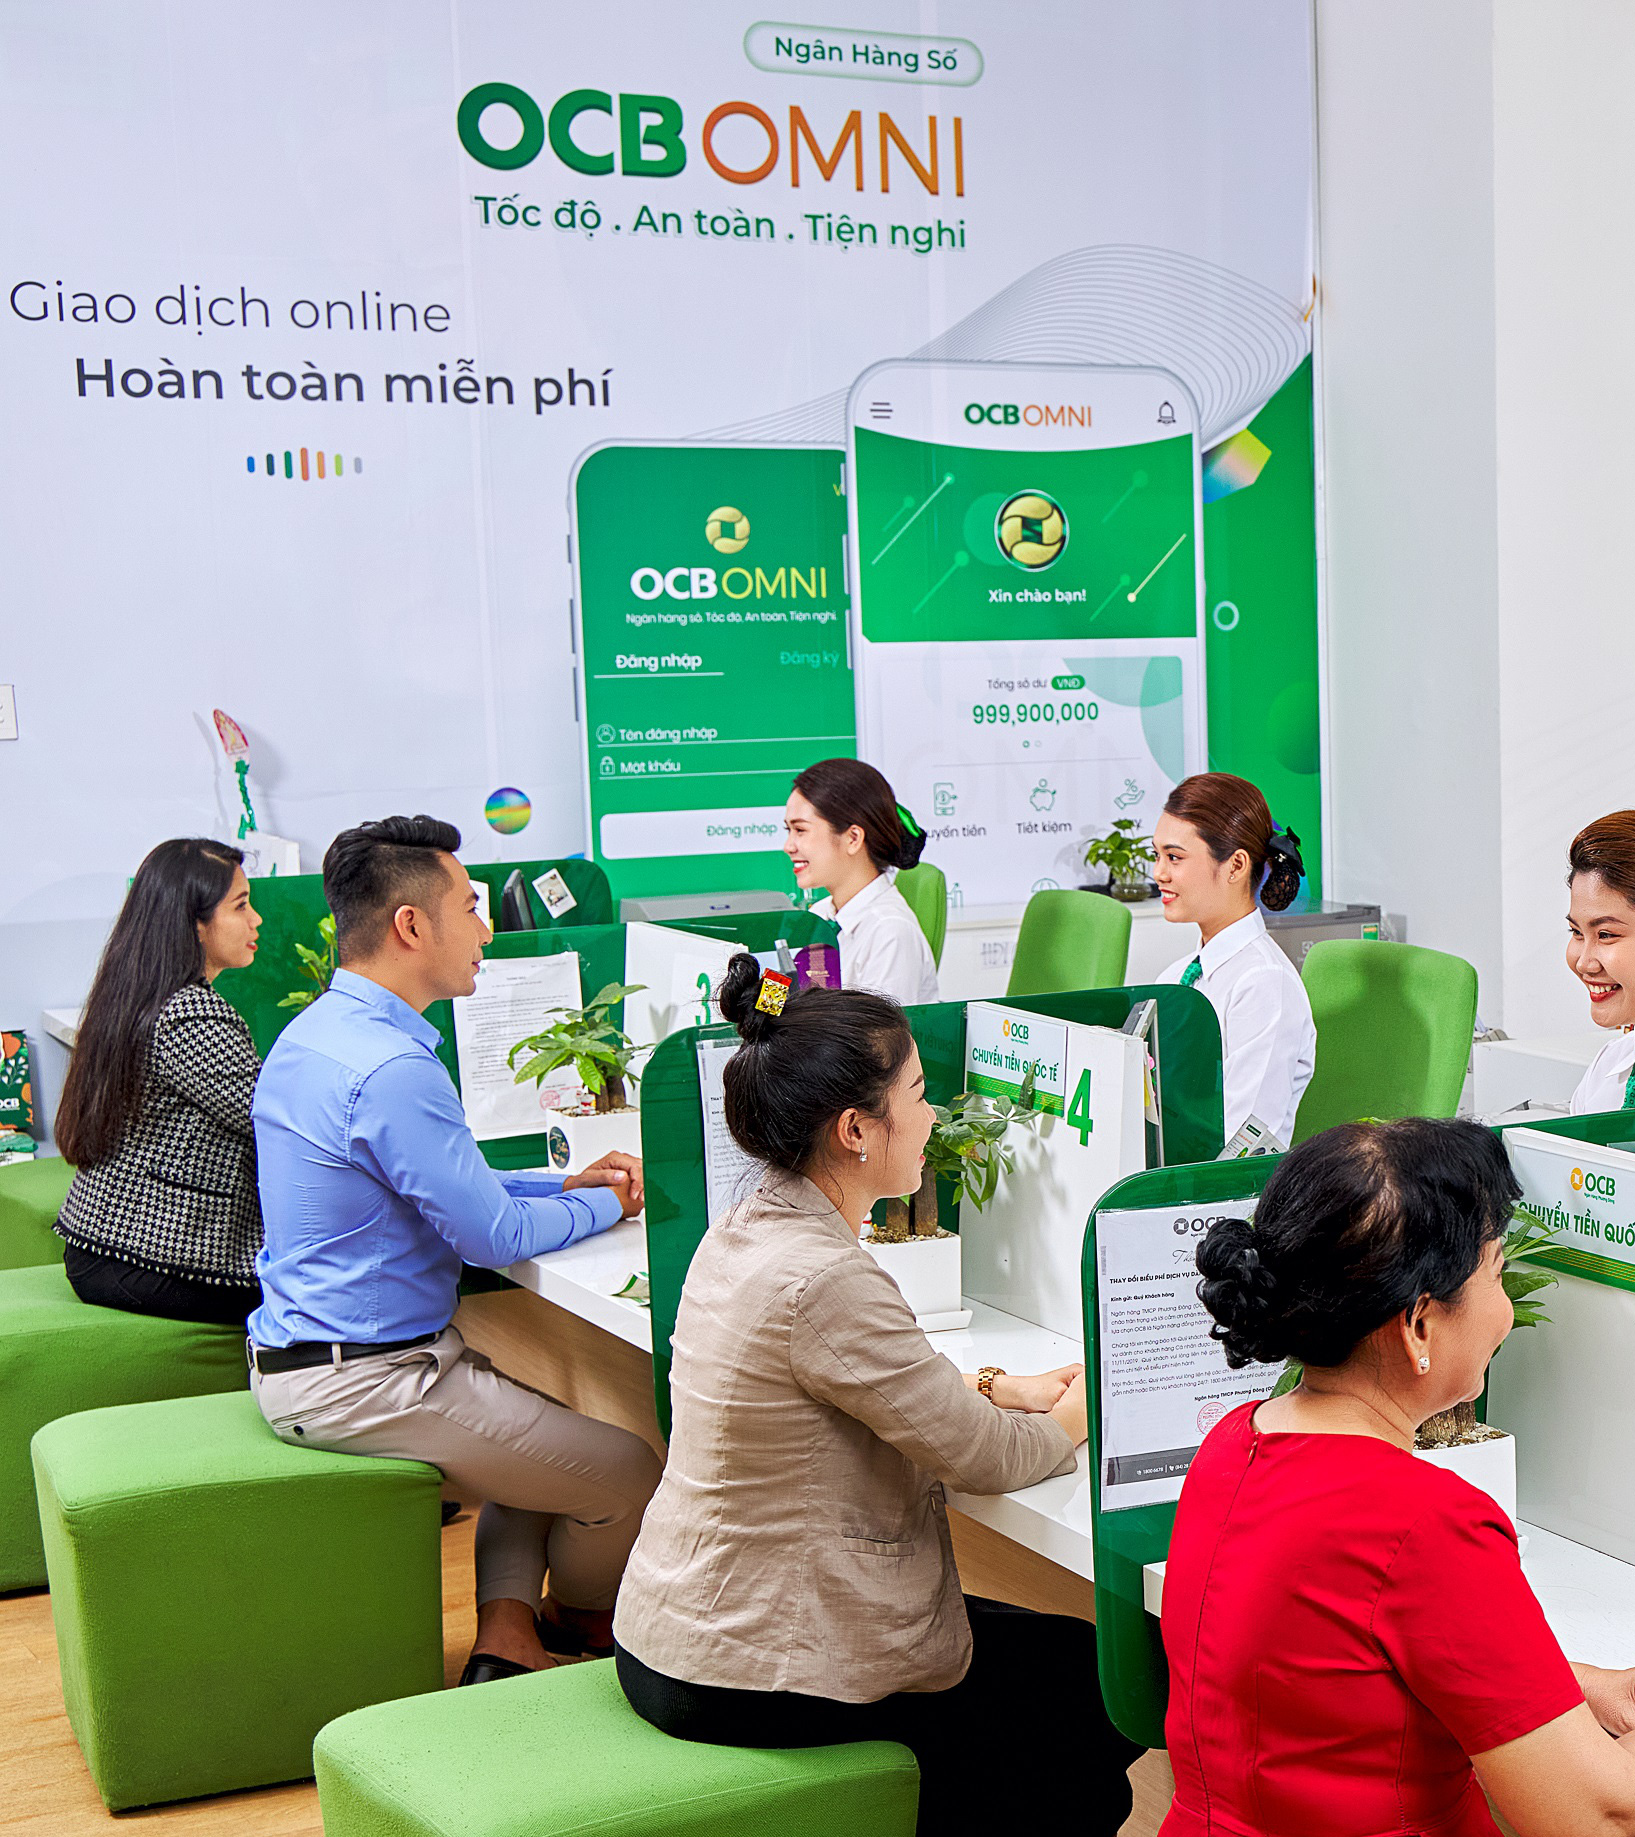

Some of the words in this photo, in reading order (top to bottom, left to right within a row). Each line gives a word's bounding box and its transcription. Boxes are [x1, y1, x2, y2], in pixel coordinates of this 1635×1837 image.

[774, 37, 843, 66] Ngân
[852, 43, 920, 72] Hàng
[927, 46, 957, 71] Số
[457, 82, 687, 178] OCB
[702, 101, 965, 197] OMNI
[474, 194, 541, 228] Tốc
[554, 200, 602, 238] độ
[634, 205, 682, 235] An
[695, 208, 776, 240] toàn
[804, 214, 878, 249] Tiện
[891, 219, 966, 254] nghi
[10, 280, 136, 326] Giao
[155, 284, 270, 335] dịch
[290, 292, 451, 333] online
[75, 356, 223, 400] Hoàn
[242, 361, 364, 403] toàn
[385, 358, 514, 406] miễn
[534, 367, 613, 415] phí
[965, 403, 1020, 426] OCB
[1023, 404, 1092, 427] OMNI
[630, 567, 718, 600] OCB
[722, 567, 827, 599] OMNI
[989, 589, 1014, 604] Xin
[1016, 588, 1052, 604] chào
[1055, 588, 1086, 606] bạn!
[615, 654, 658, 672] Đăng
[661, 653, 702, 670] nhập
[972, 702, 1099, 726] 999,900,000
[695, 973, 711, 1026] 3
[1011, 1023, 1029, 1040] OCB
[972, 1045, 1002, 1068] CHUYỂN
[1004, 1050, 1020, 1072] TIỀN
[1049, 1062, 1059, 1081] TẾ
[1067, 1068, 1093, 1147] 4
[1585, 1172, 1616, 1196] OCB
[1573, 1208, 1600, 1238] TIỀN
